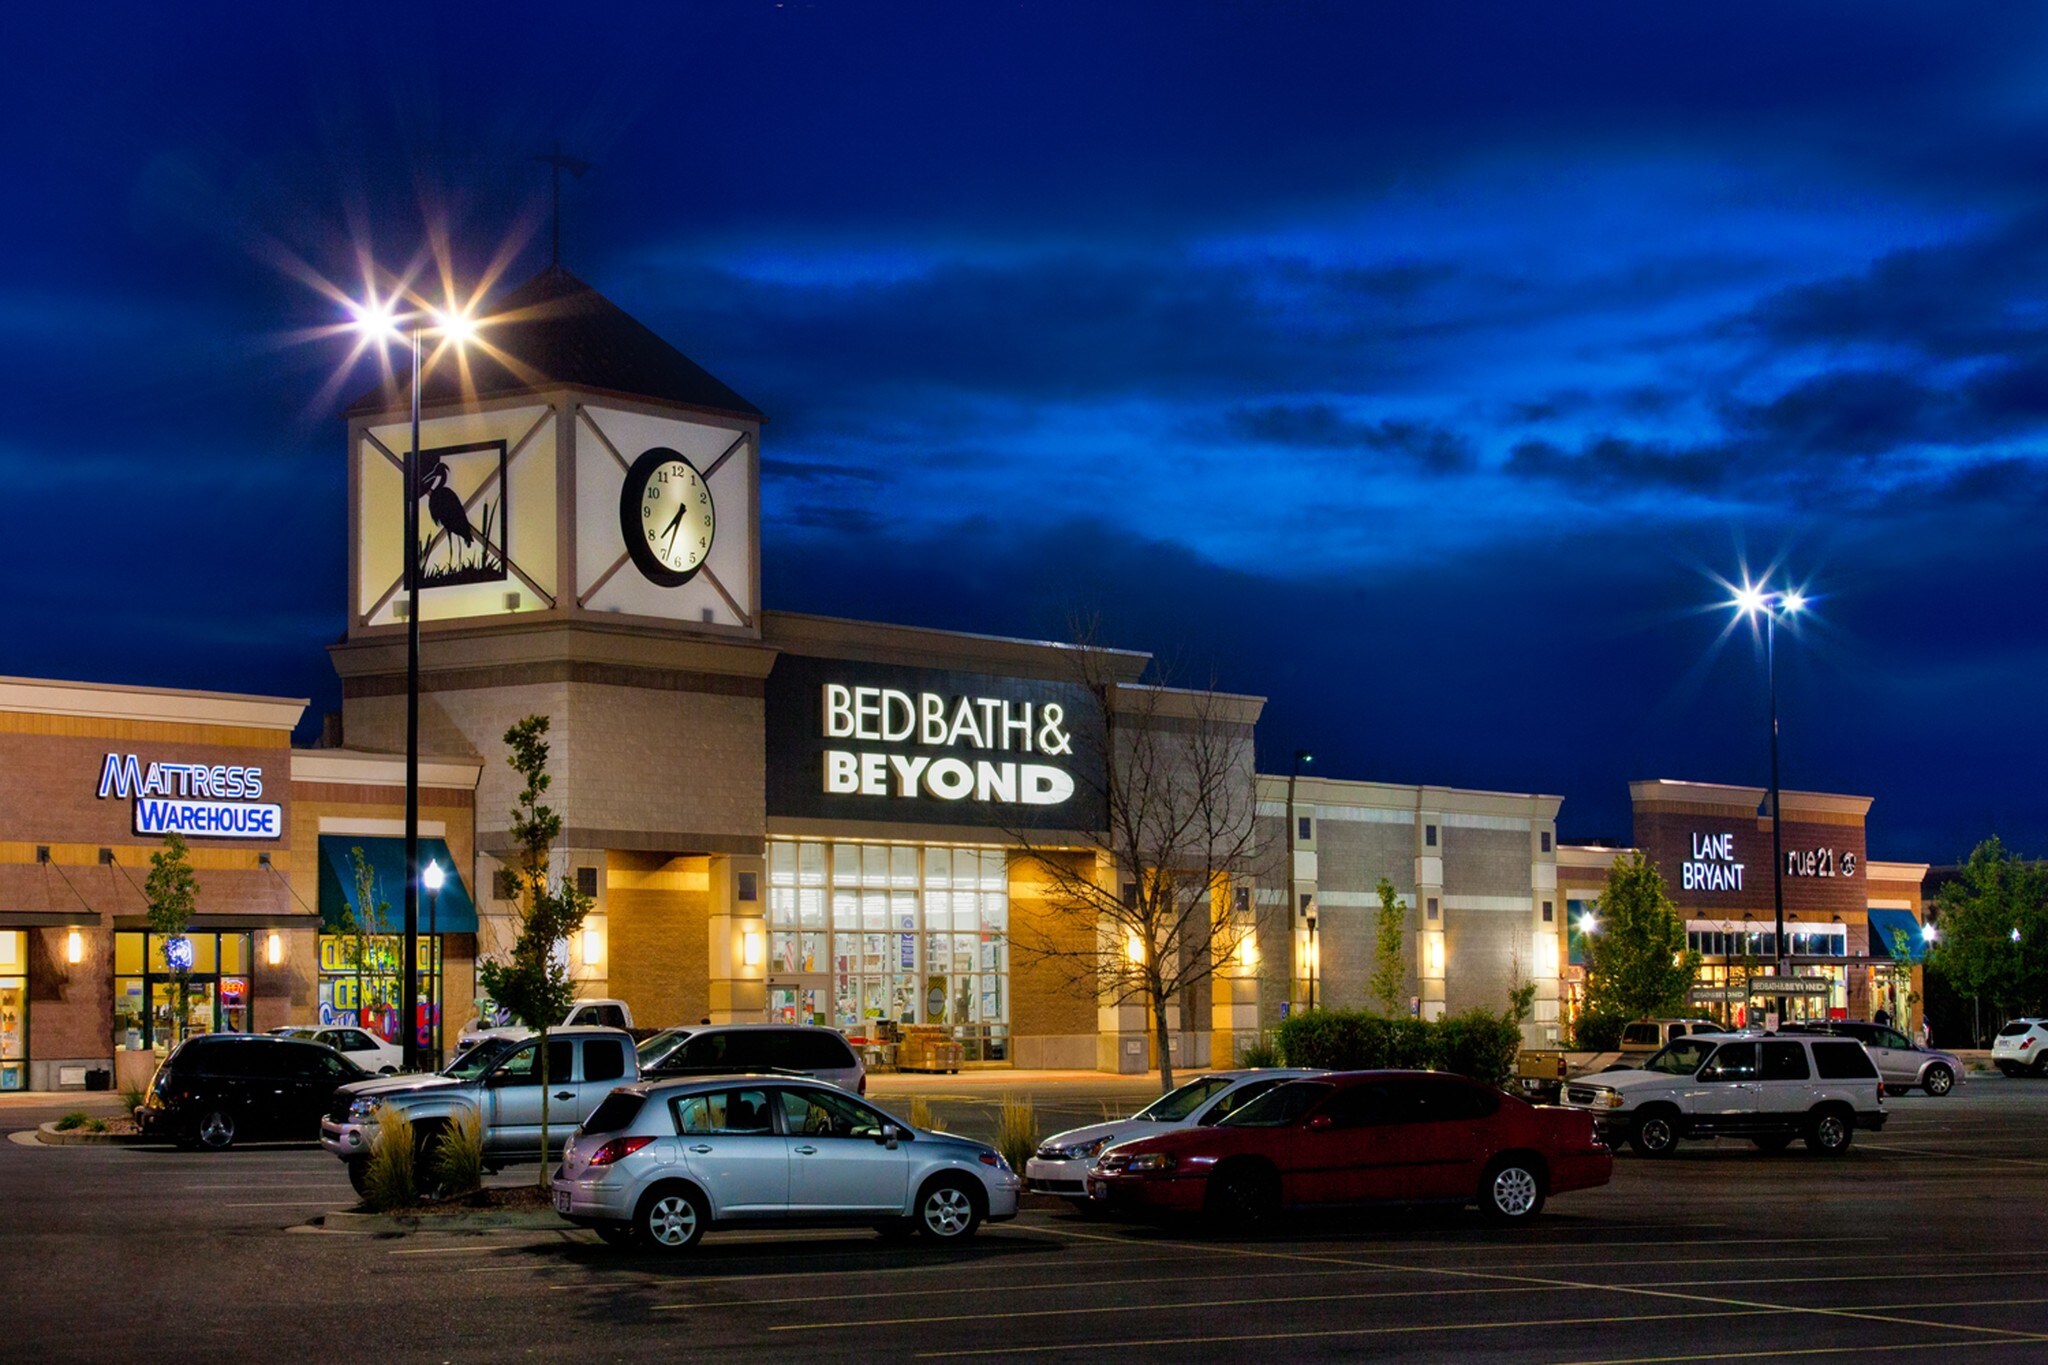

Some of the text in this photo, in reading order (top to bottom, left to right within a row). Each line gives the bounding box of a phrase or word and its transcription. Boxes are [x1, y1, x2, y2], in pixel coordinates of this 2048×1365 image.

[658, 472, 668, 483] 11
[672, 466, 684, 478] 12
[691, 475, 696, 486] 1
[648, 488, 660, 499] 10
[700, 492, 707, 504] 2
[644, 506, 651, 518] 9
[704, 515, 711, 527] 3
[648, 529, 655, 541] 8
[699, 537, 706, 548] 4
[660, 548, 667, 560] 7
[689, 552, 696, 564] 5
[674, 556, 681, 568] 6
[823, 683, 1073, 756] BED BATH &
[99, 753, 263, 799] MATTRESS
[823, 750, 1076, 806] BEYOND
[139, 800, 274, 833] WAREHOUSE
[1692, 832, 1734, 861] LANE
[1682, 862, 1745, 891] BRYANT
[222, 983, 246, 993] OPEN
[1785, 983, 1826, 992] BEYOND
